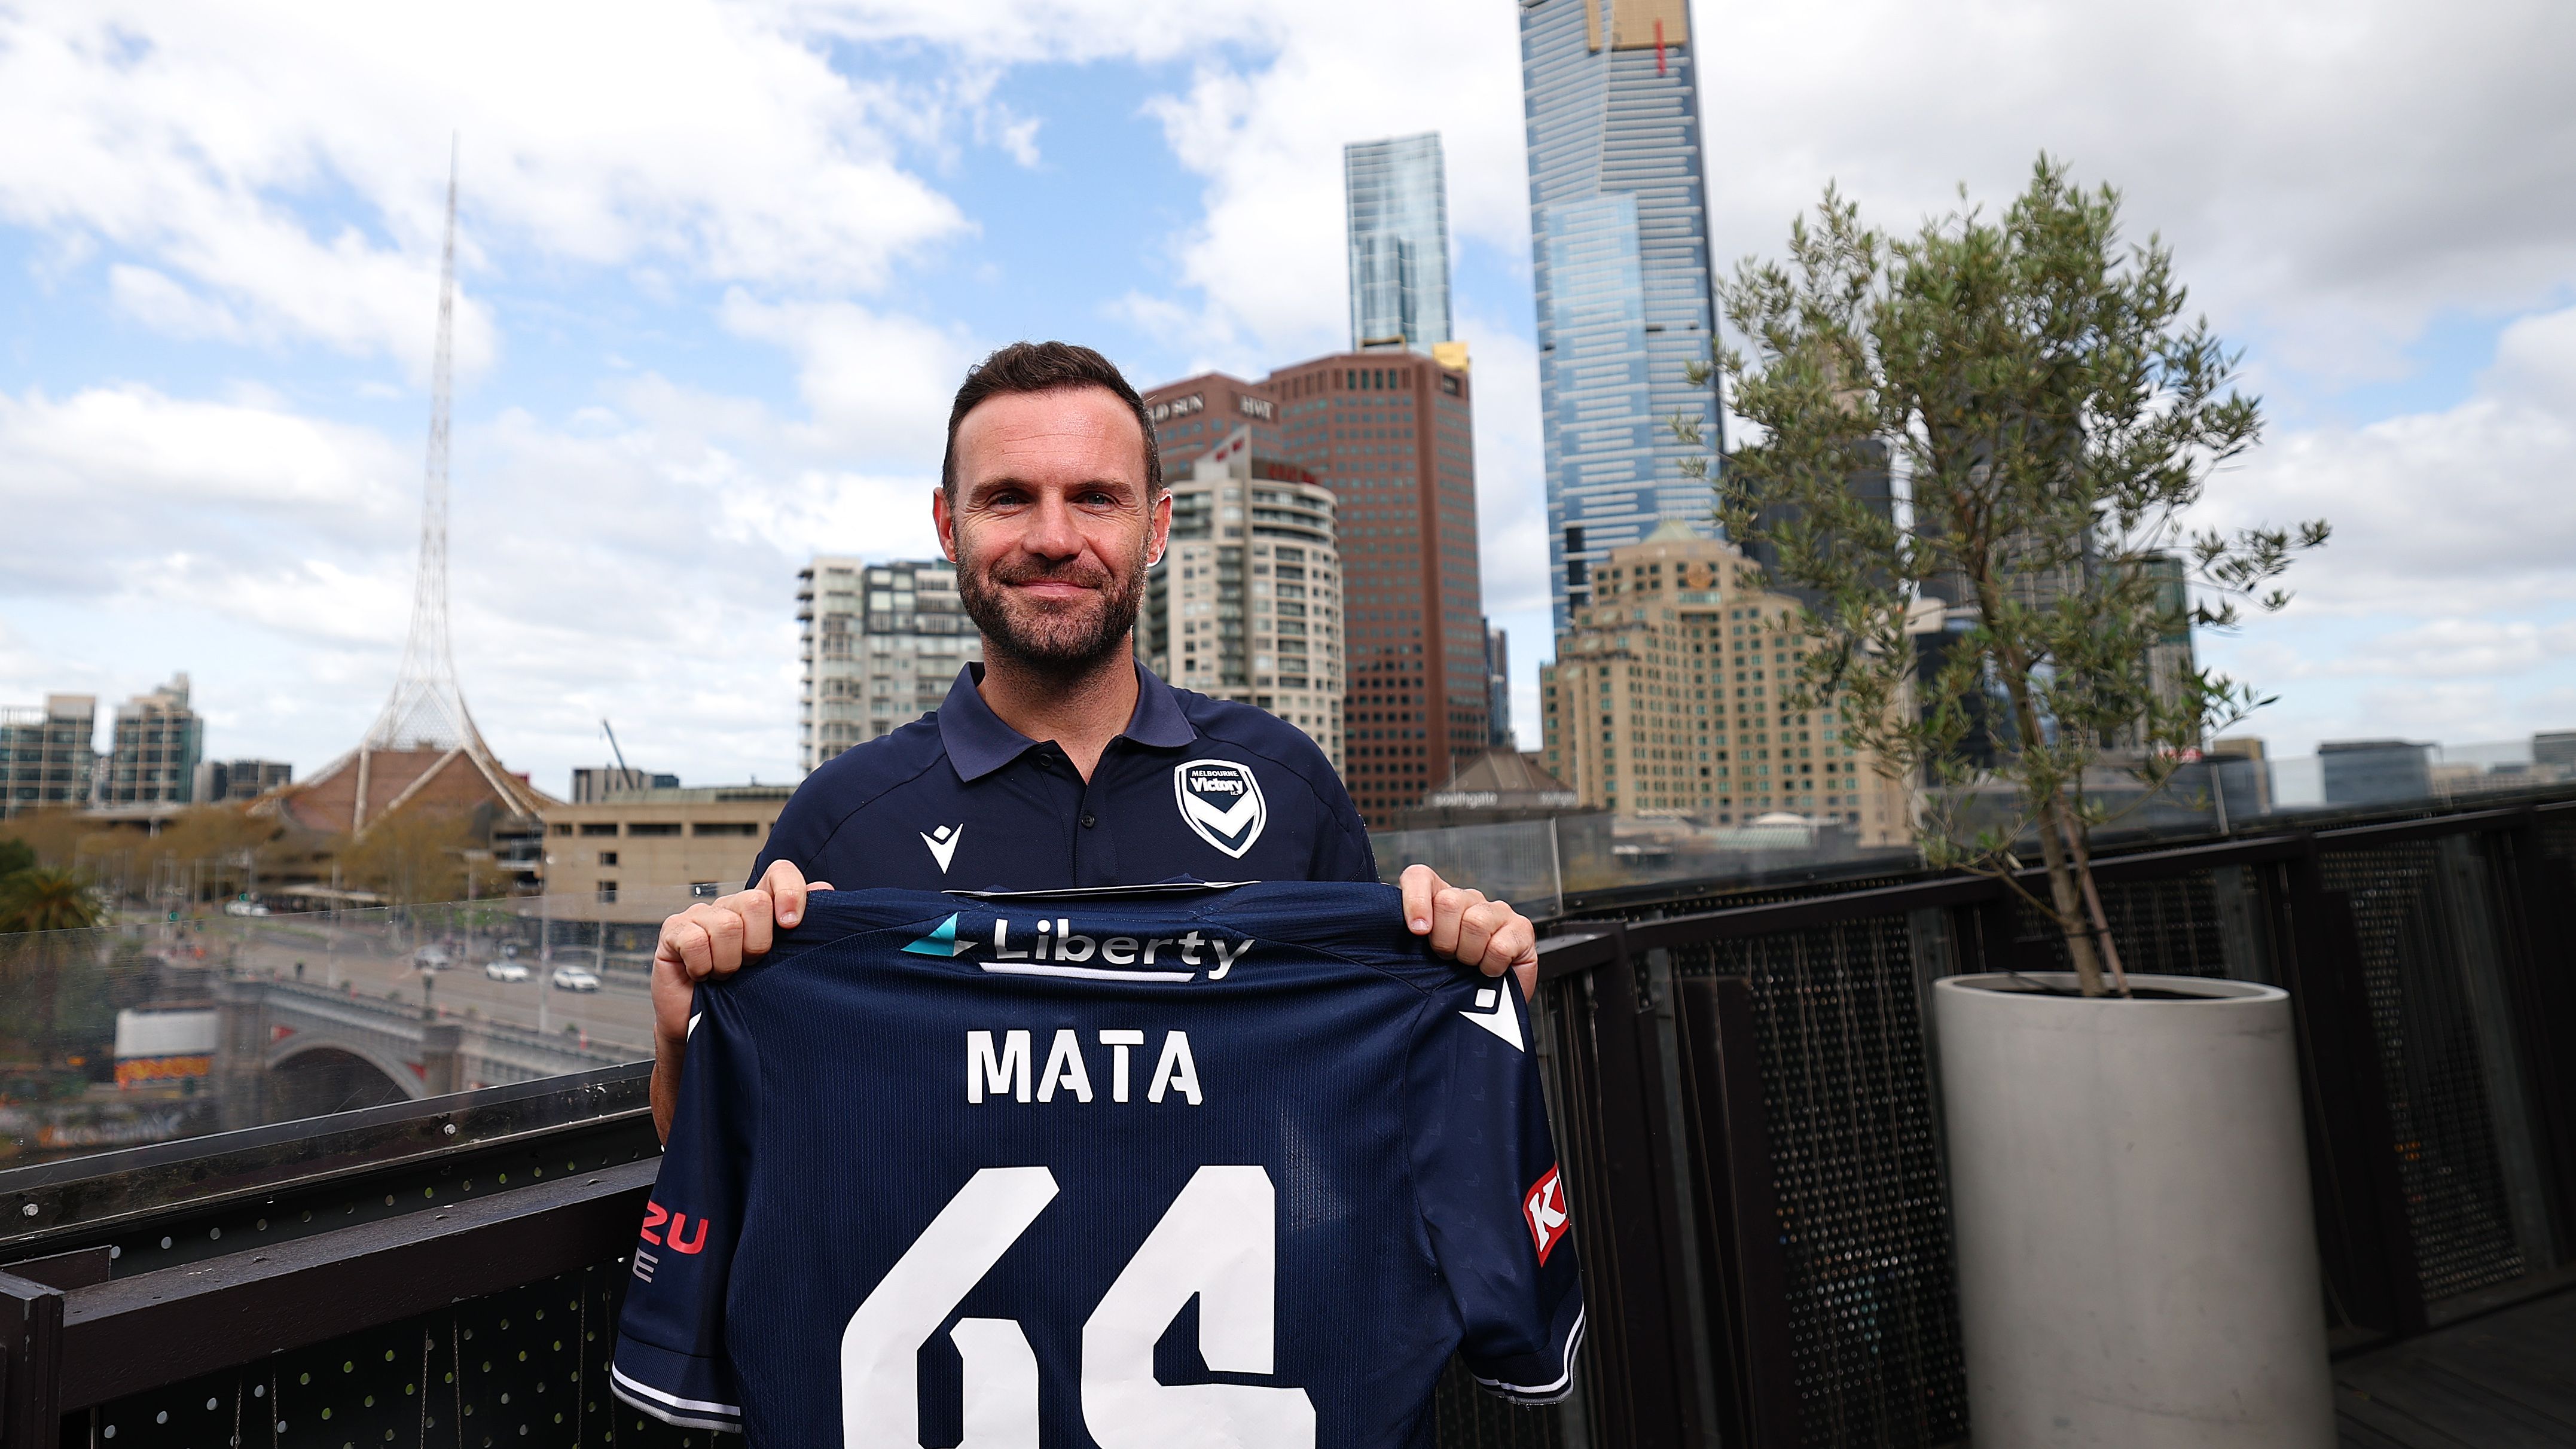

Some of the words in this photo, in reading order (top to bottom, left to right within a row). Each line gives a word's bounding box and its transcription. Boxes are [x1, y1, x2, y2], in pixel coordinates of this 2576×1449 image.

[1240, 394, 1274, 422] HWT
[1189, 777, 1243, 795] Victory
[1433, 792, 1498, 809] southgate
[994, 918, 1255, 980] Liberty
[967, 1029, 1203, 1106] MATA
